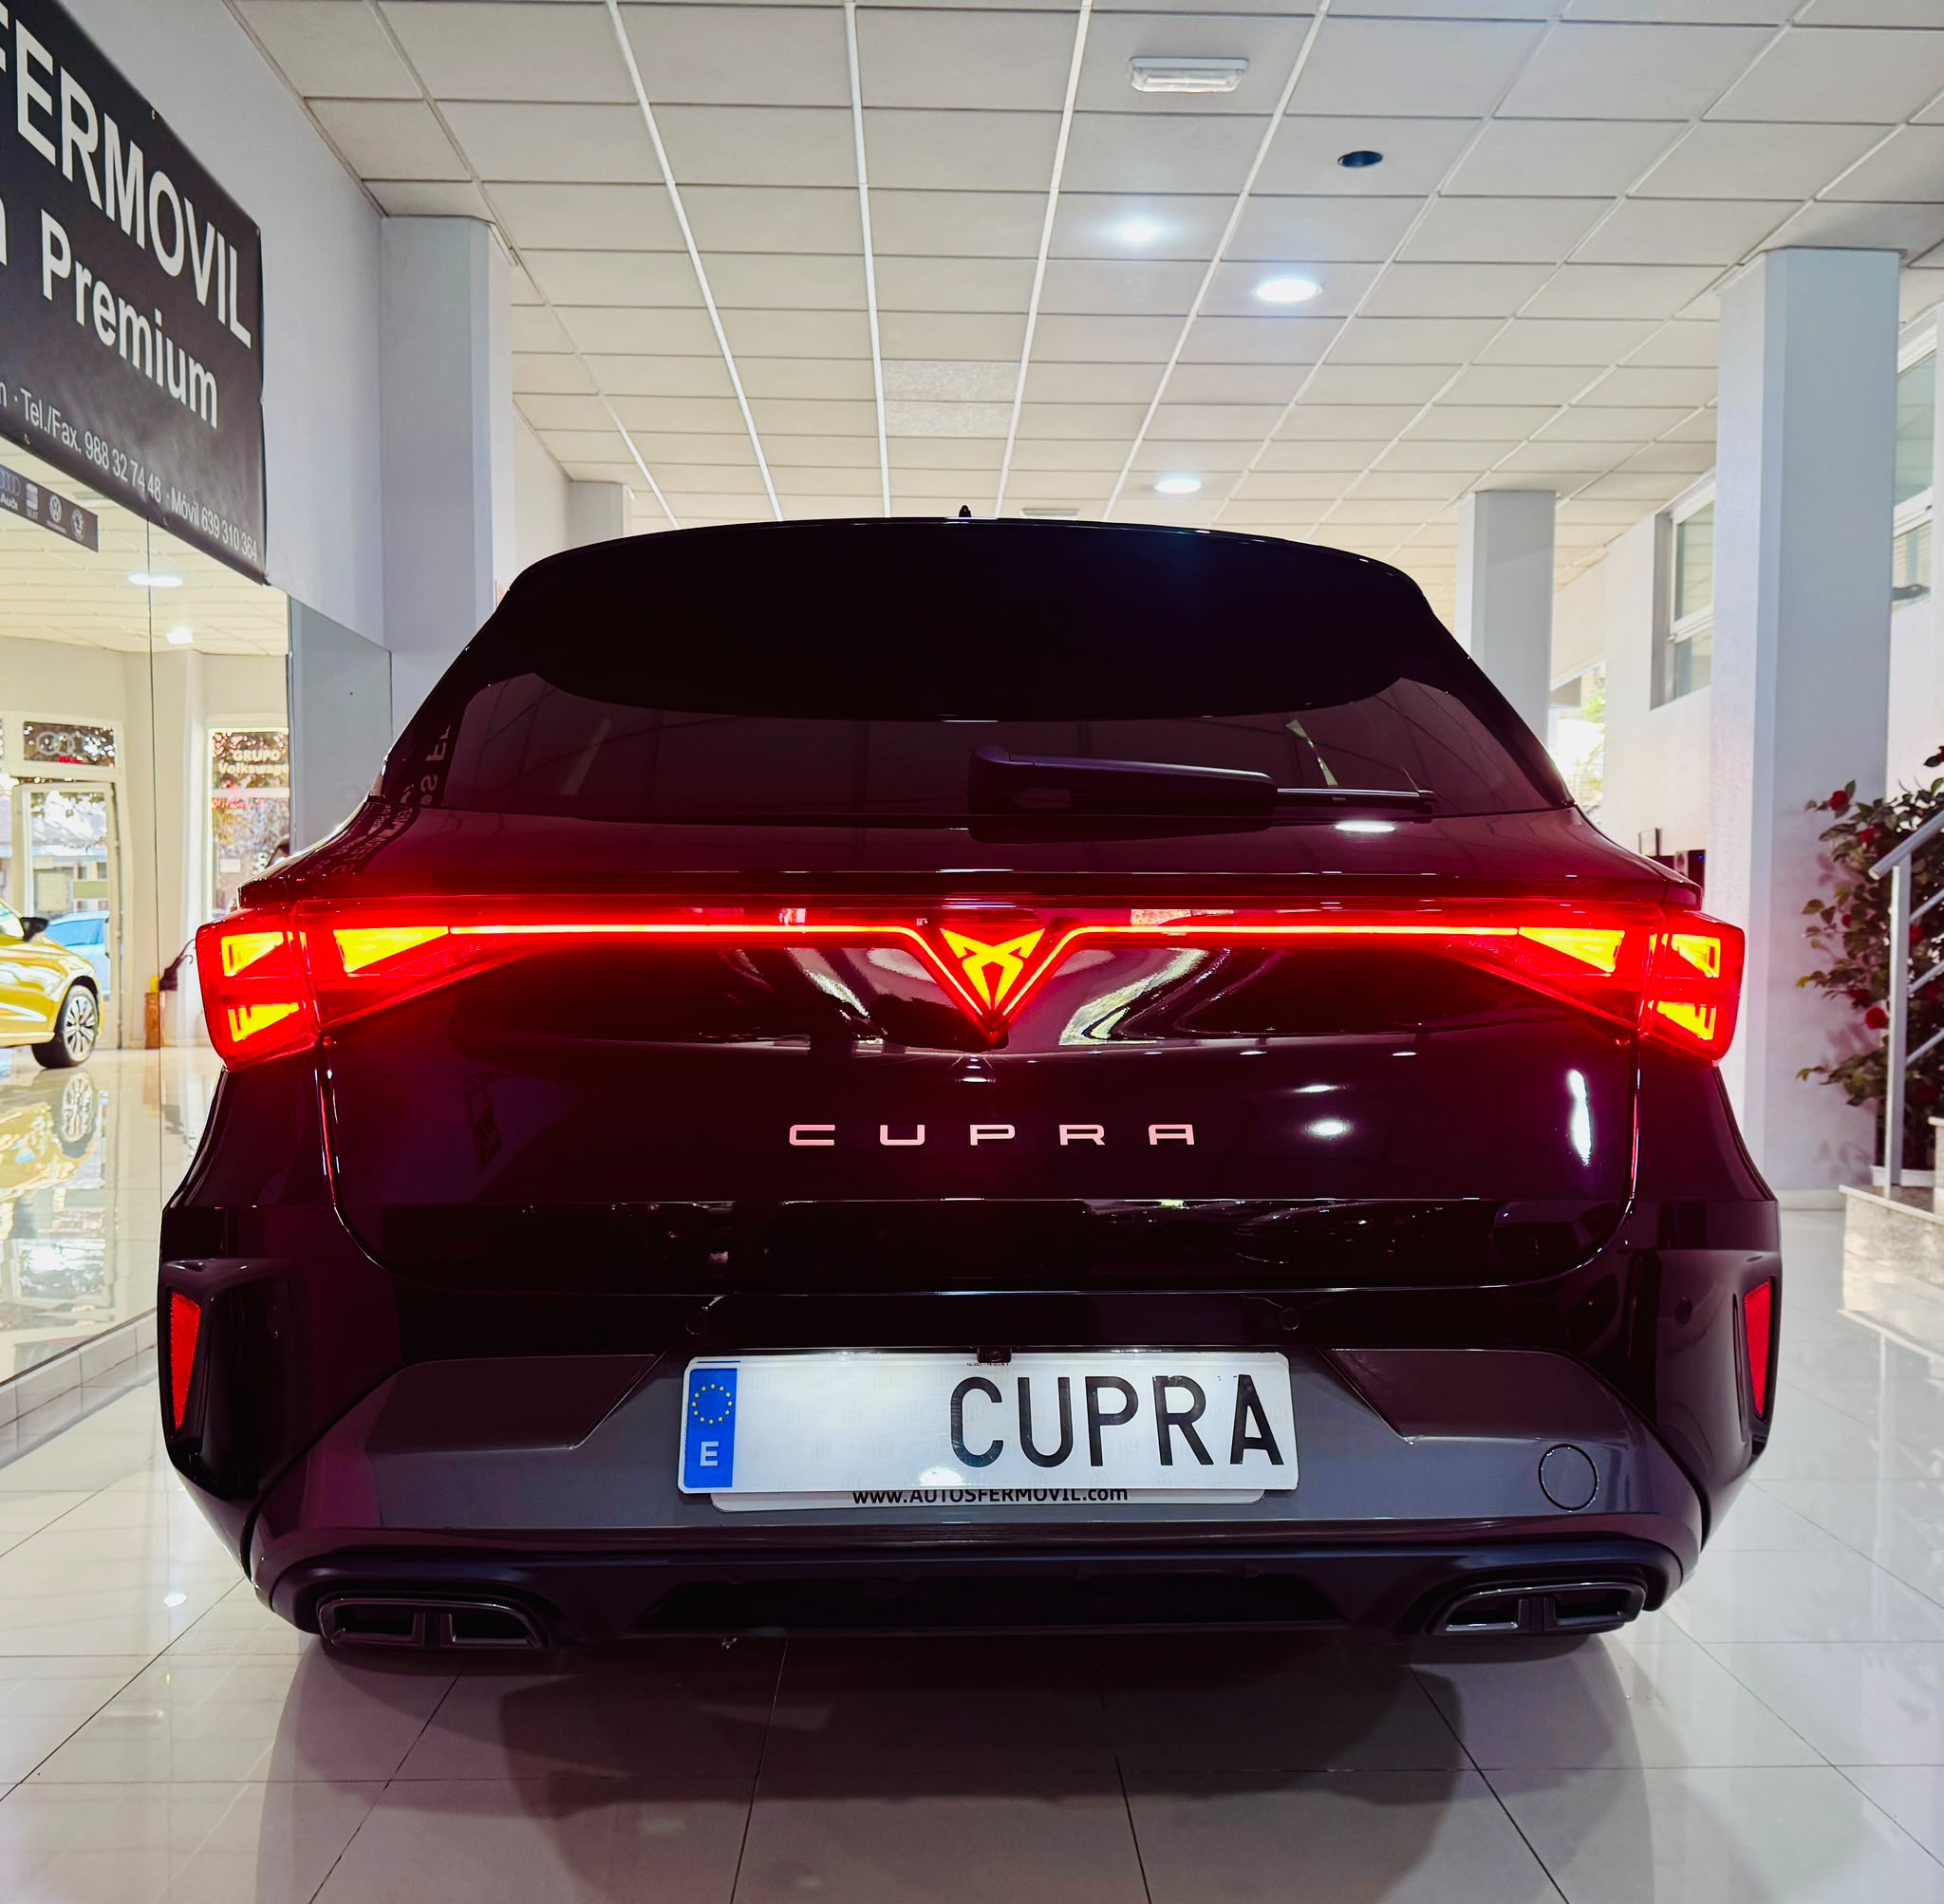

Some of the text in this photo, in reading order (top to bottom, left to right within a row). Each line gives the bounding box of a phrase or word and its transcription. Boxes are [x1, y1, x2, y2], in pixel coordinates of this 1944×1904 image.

[0, 2, 252, 349] ERMOVIL
[41, 209, 217, 429] Premium
[20, 387, 82, 454] Tel./Fax.
[84, 431, 110, 471] 988
[112, 448, 128, 482] 32
[130, 459, 146, 495] 74
[147, 473, 161, 503] 48
[201, 507, 220, 540] 639
[222, 520, 240, 551] 310
[241, 532, 258, 562] 364
[233, 749, 281, 762] GRUPO
[789, 1124, 1195, 1147] CUPRA
[700, 1373, 1284, 1467] E CUPRA
[852, 1487, 1129, 1504] www.AUTOSFERMOVIL.com
